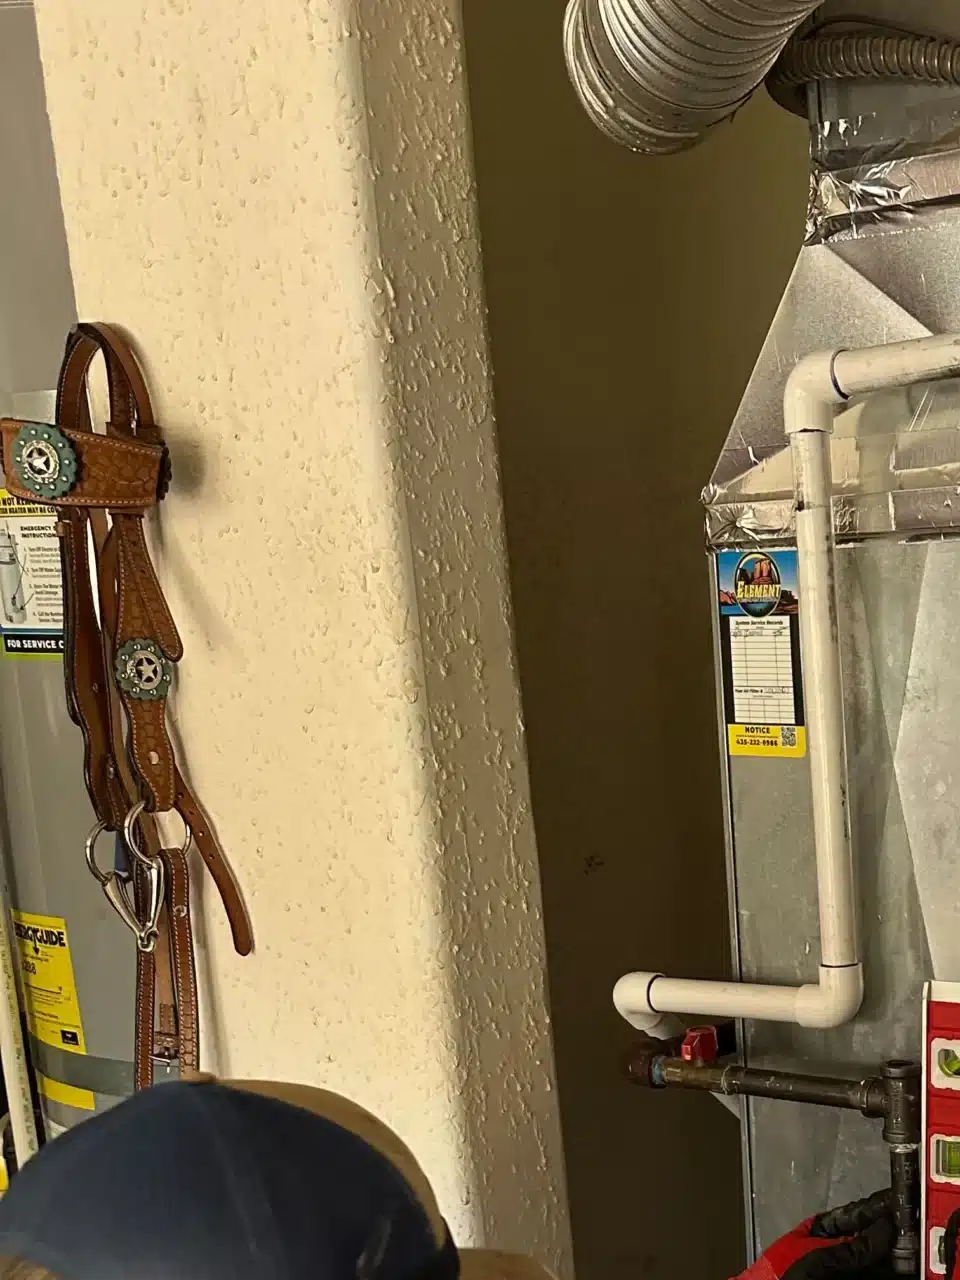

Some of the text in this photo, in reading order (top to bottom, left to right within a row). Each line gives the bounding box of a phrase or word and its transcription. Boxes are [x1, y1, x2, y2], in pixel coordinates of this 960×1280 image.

[737, 581, 780, 598] ELEMENT
[8, 640, 21, 648] FOR
[23, 640, 56, 648] SERVICE
